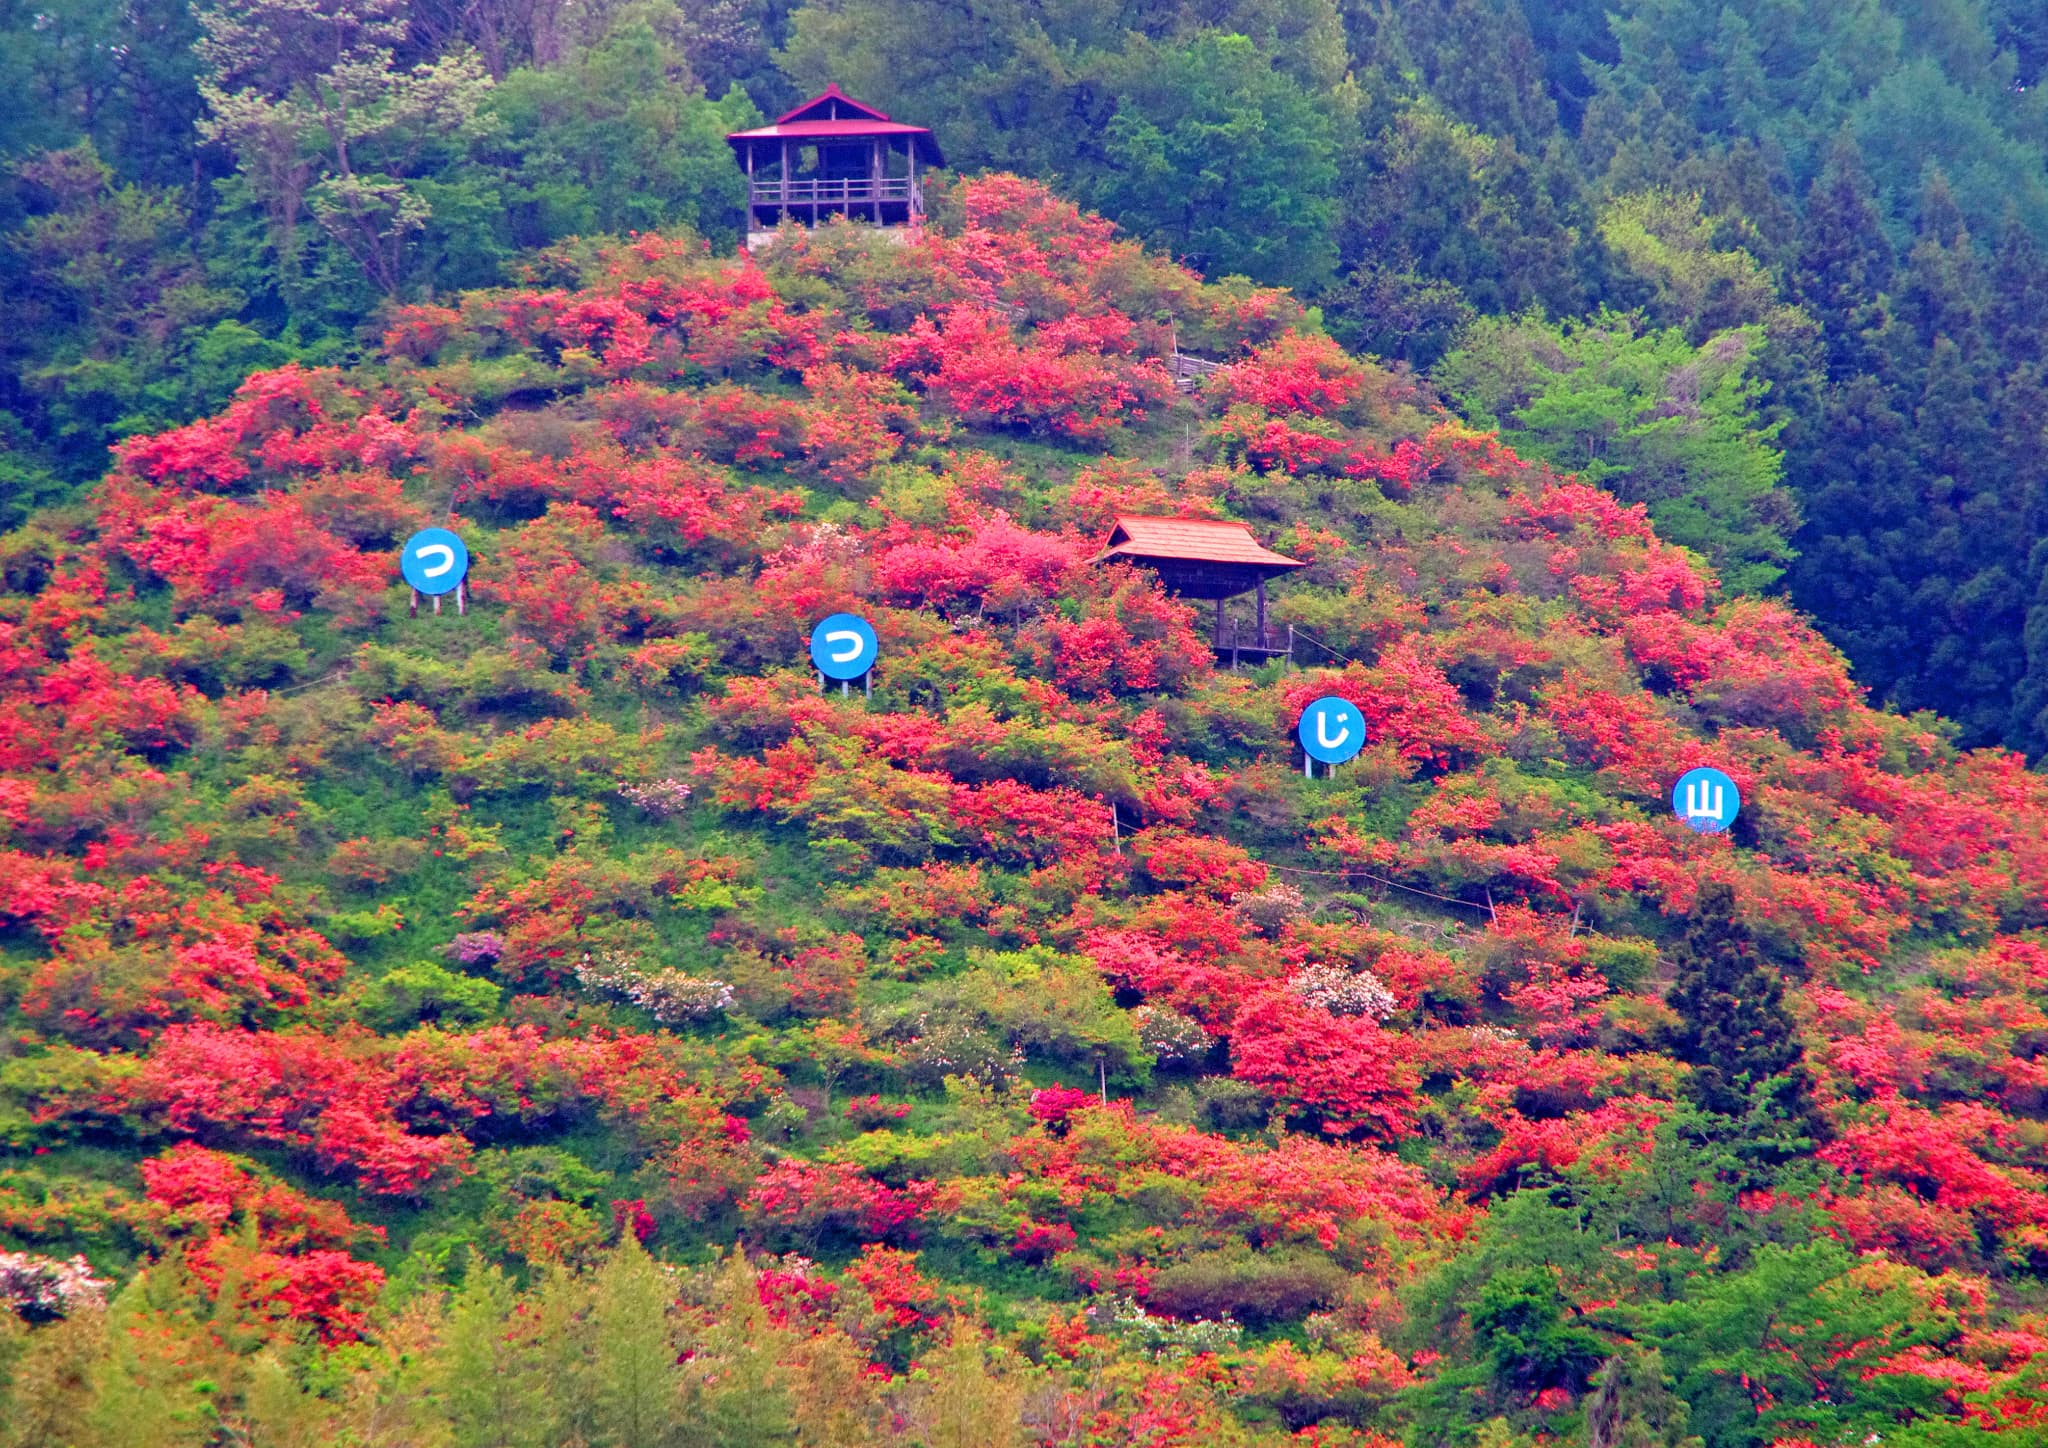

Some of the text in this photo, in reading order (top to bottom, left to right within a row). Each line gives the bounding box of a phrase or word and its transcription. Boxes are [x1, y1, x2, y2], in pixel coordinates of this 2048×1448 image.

[416, 544, 455, 578] つ
[825, 630, 864, 663] つ
[1317, 711, 1350, 749] じ
[1687, 779, 1723, 820] 山
